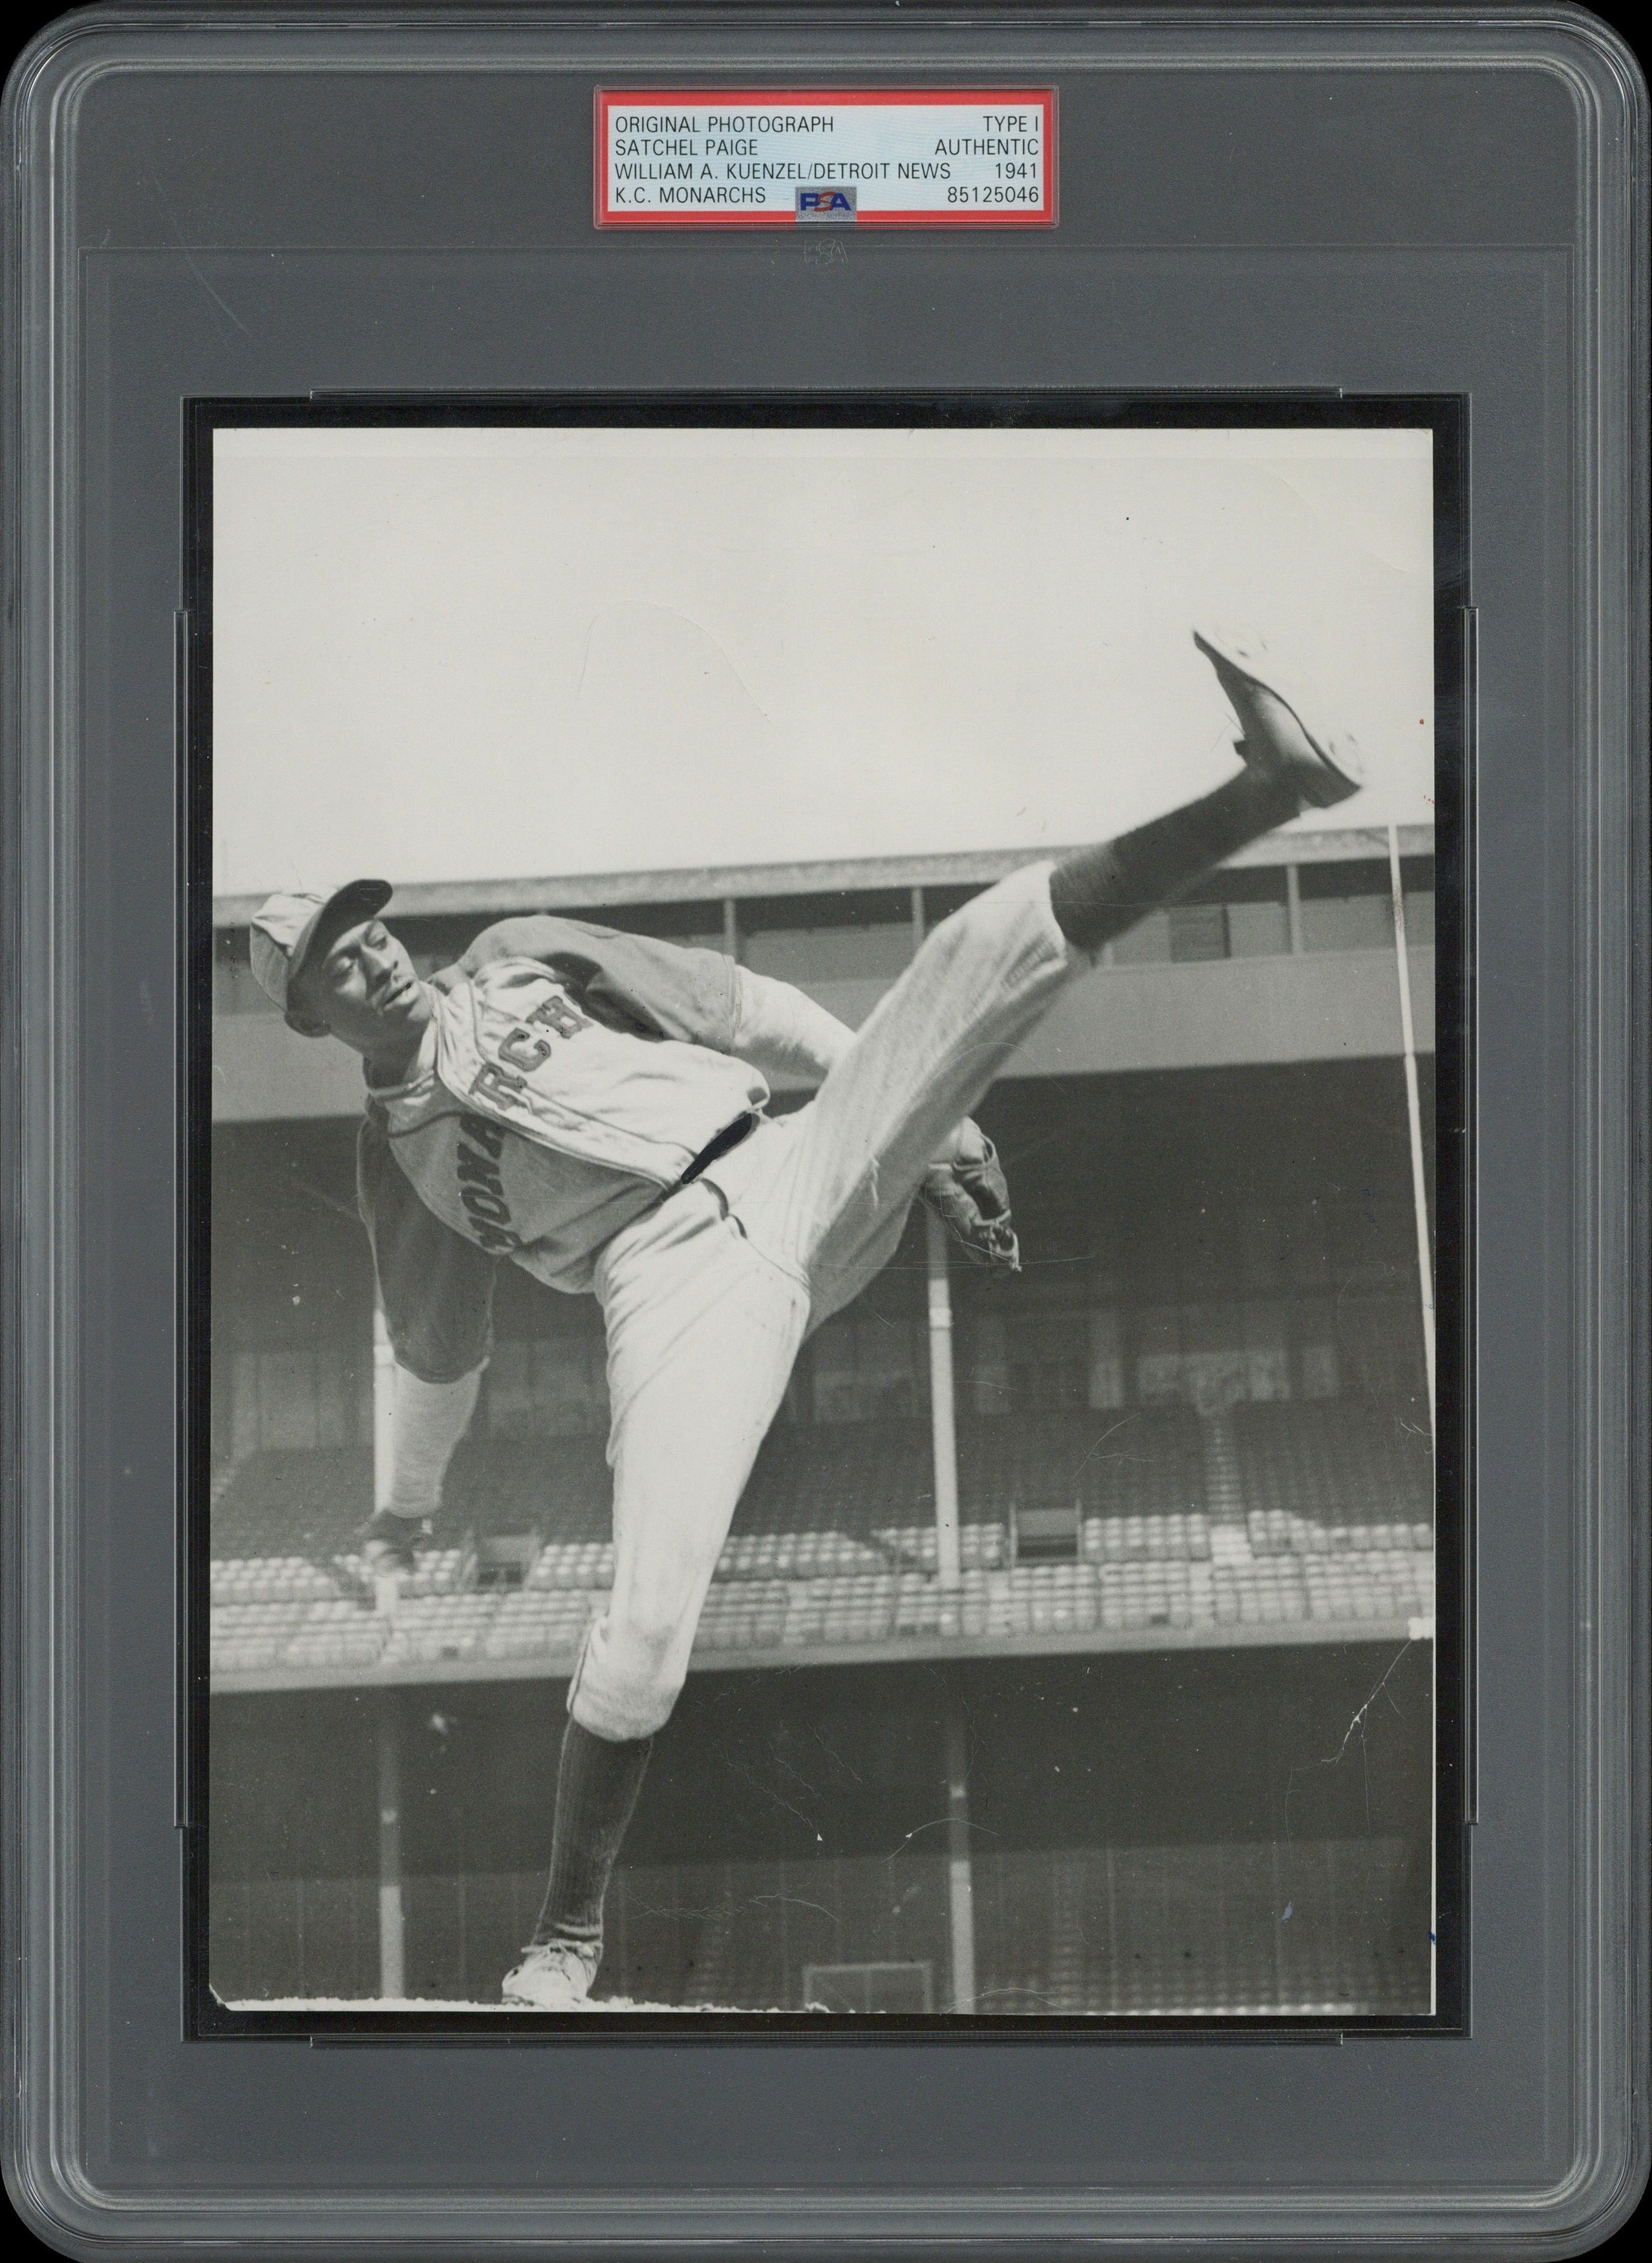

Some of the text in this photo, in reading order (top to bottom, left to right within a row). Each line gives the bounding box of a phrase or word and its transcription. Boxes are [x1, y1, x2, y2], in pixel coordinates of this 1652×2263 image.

[616, 116, 833, 133] ORIGINAL PHOTOGRAPH
[982, 116, 1027, 133] TYPE
[615, 139, 758, 156] SATCHEL PAIGE
[934, 138, 1039, 156] AUTHENTIC
[614, 162, 951, 180] WILLIAM A. KUENZEL/DETROIT NEWS
[994, 162, 1037, 179] 1941
[616, 186, 766, 204] K.C. MONARCHS
[800, 191, 852, 212] PSA
[947, 186, 1039, 203] 85125046
